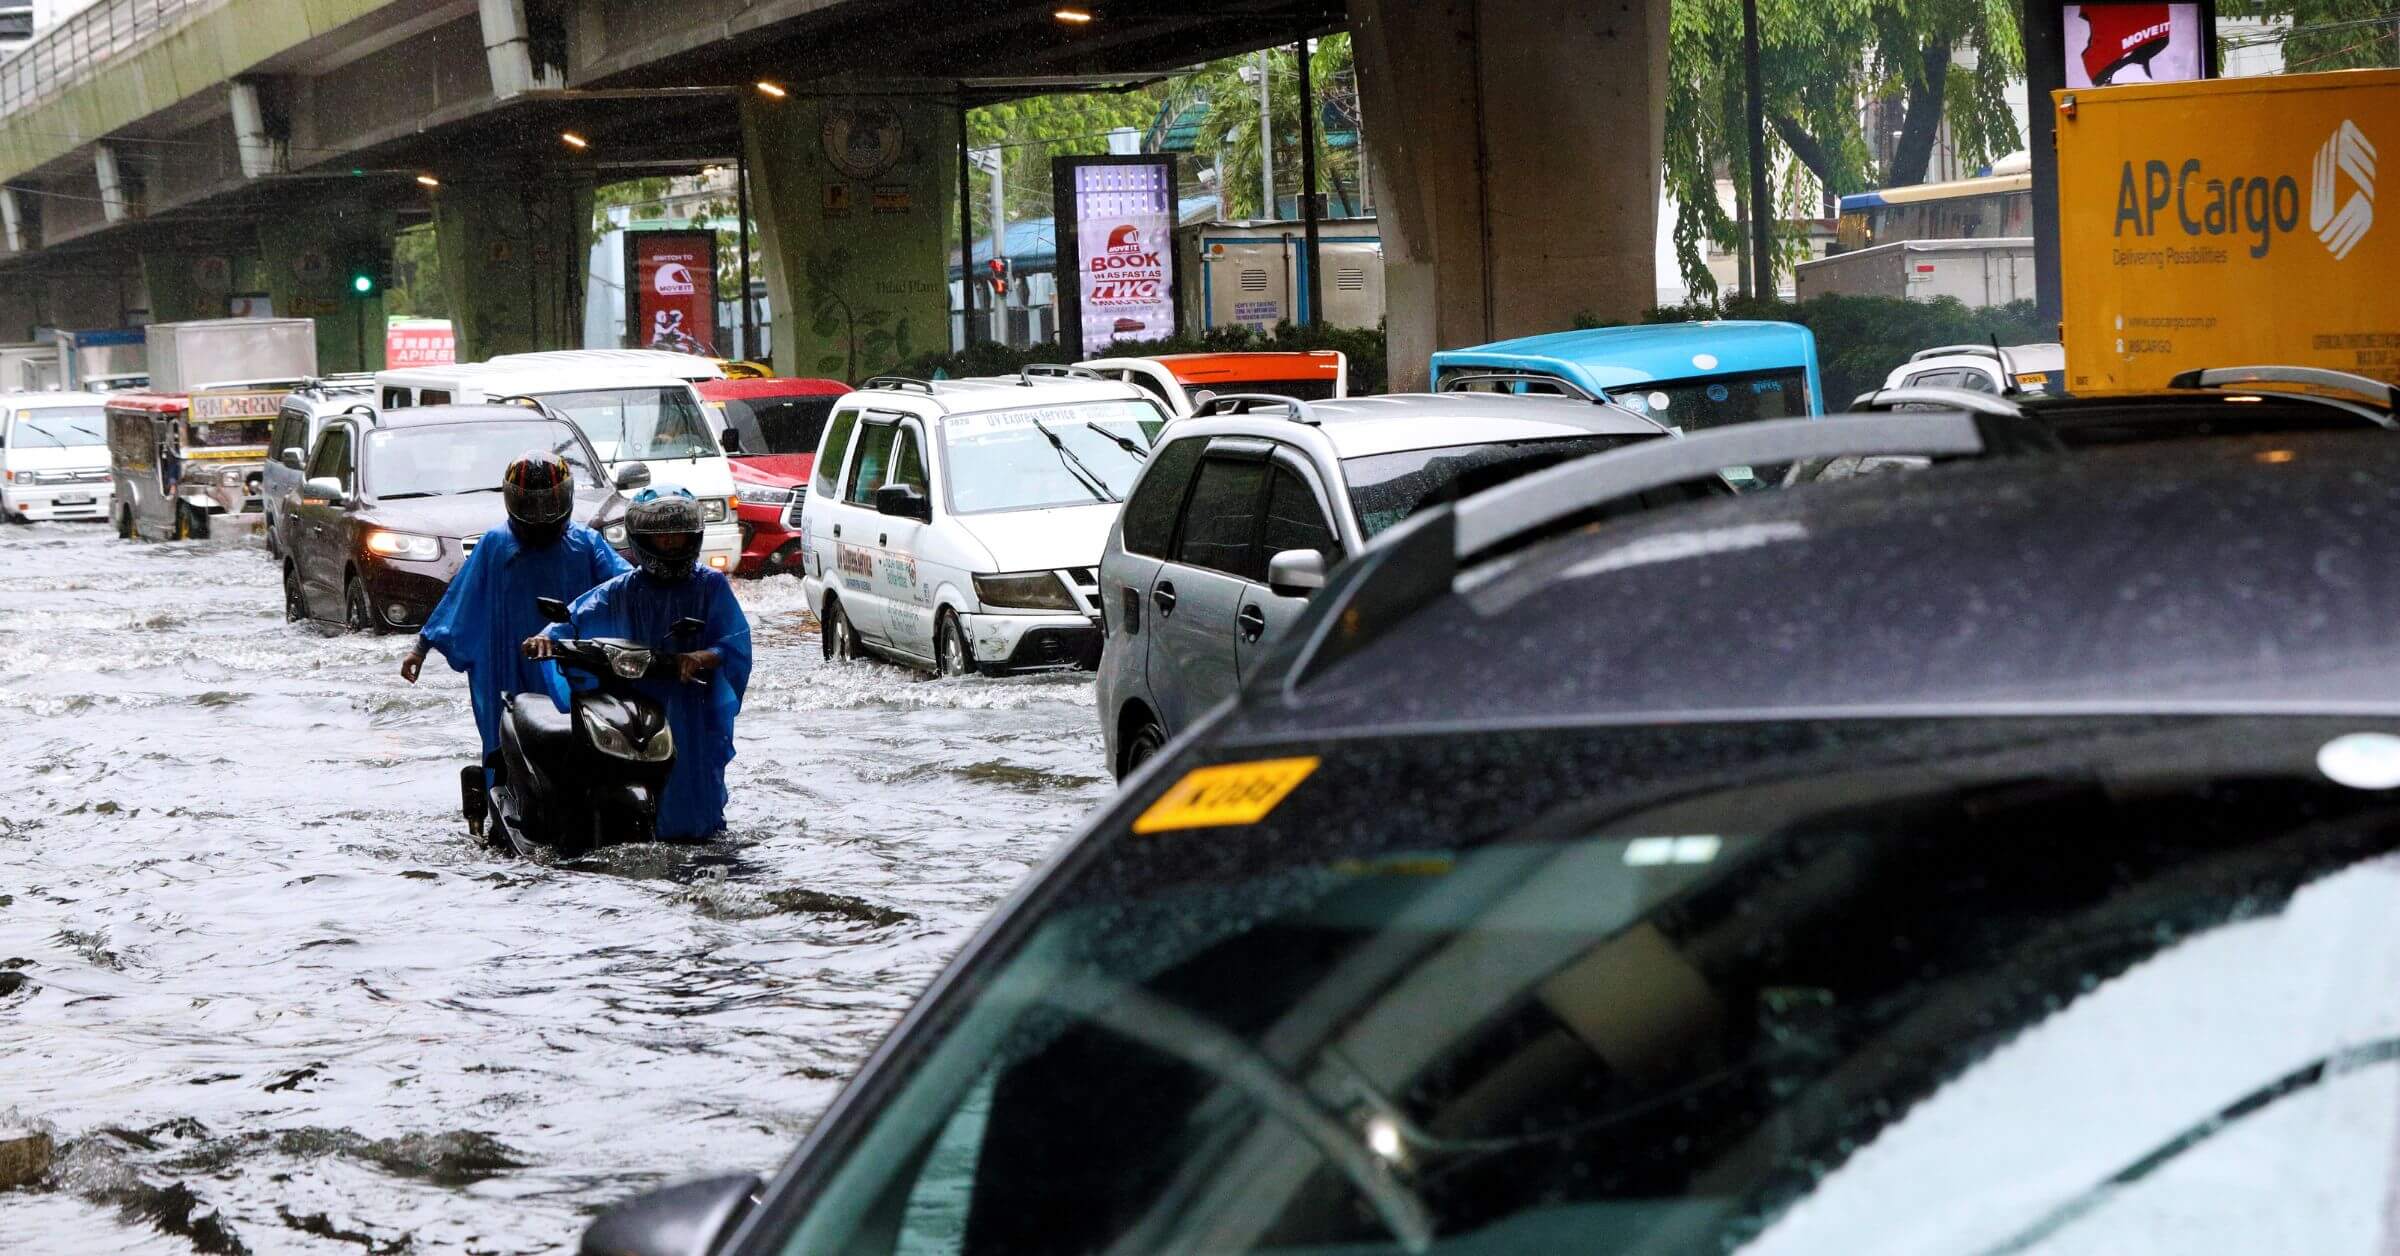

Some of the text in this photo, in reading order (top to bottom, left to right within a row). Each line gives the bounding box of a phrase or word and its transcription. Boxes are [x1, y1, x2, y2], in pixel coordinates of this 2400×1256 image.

[2121, 25, 2159, 50] MOVE
[2113, 158, 2299, 259] AP Cargo
[1091, 252, 1161, 272] BOOK
[2112, 247, 2228, 269] Delivering Possibilities
[1122, 270, 1147, 278] FAST
[1093, 279, 1160, 299] TWO
[1040, 409, 1076, 423] Service
